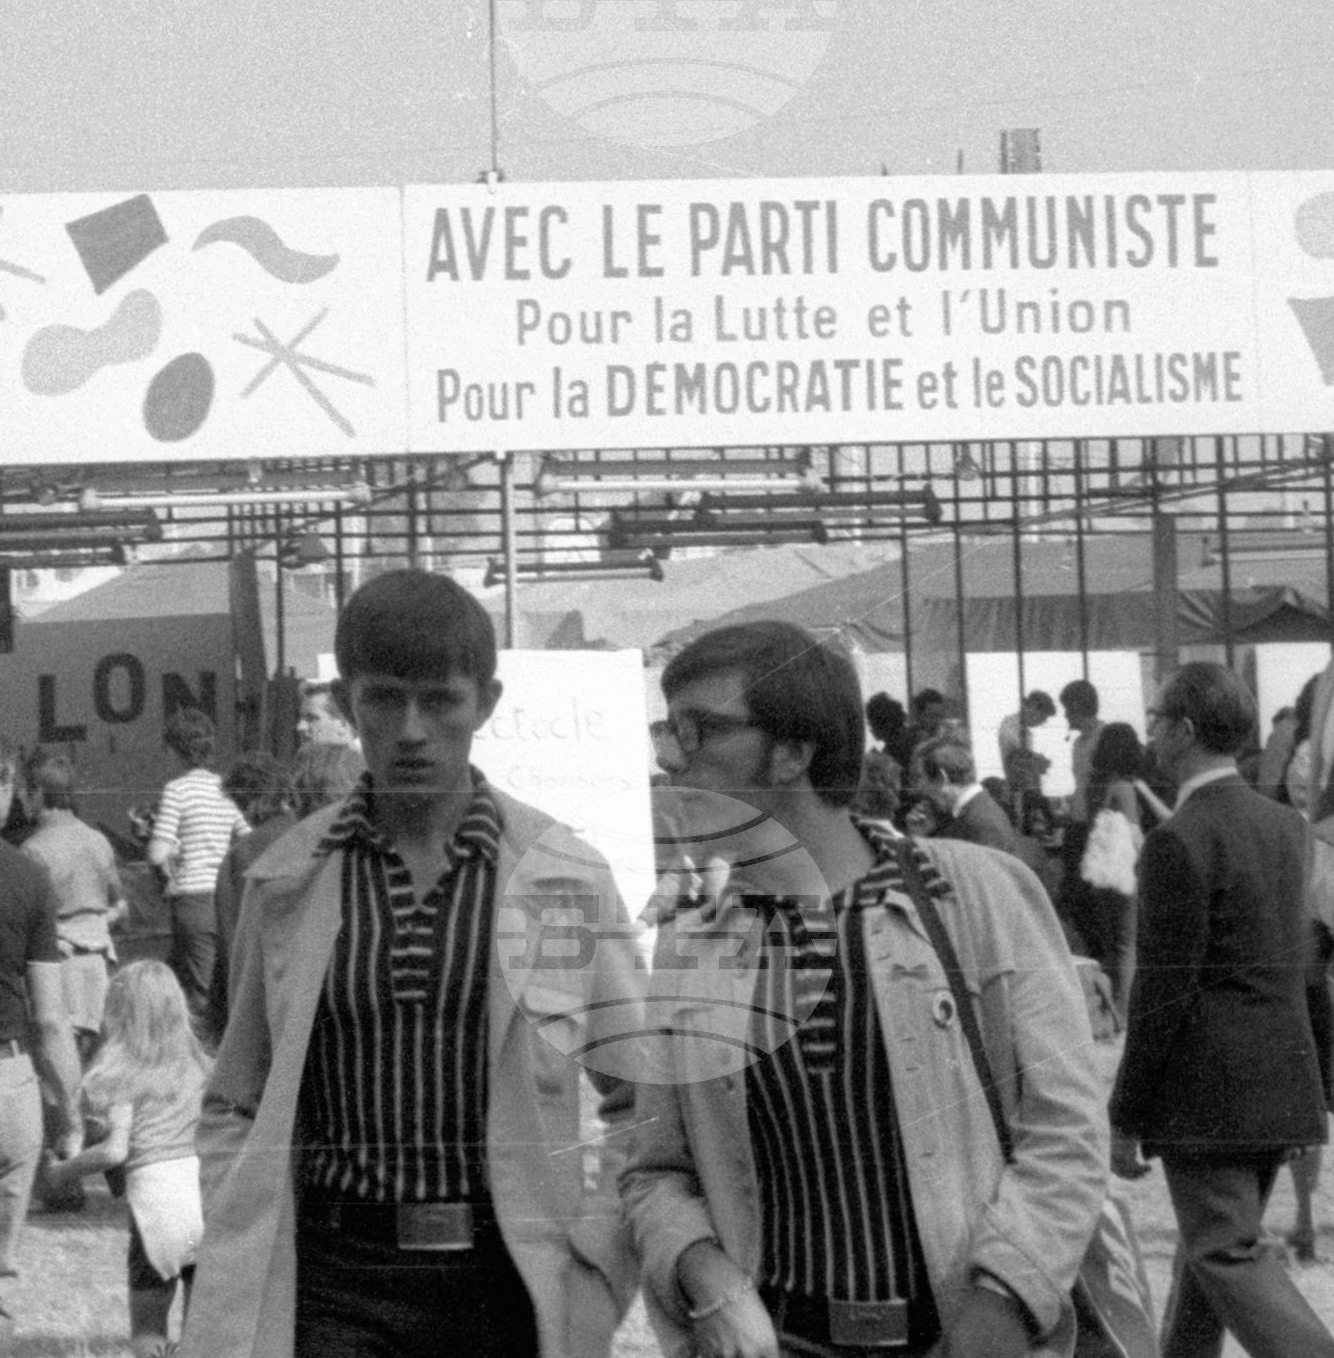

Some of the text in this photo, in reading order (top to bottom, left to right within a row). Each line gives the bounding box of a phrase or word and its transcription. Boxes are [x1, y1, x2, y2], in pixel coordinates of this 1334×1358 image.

[426, 192, 1219, 283] AVEC LE PARTI COMMUNISTE
[516, 287, 1131, 346] Pour la Lutte et l'Union
[436, 367, 536, 424] Pour
[552, 365, 590, 420] la
[916, 361, 959, 410] et
[972, 356, 1006, 409] le
[1014, 350, 1243, 408] SOCIALISME
